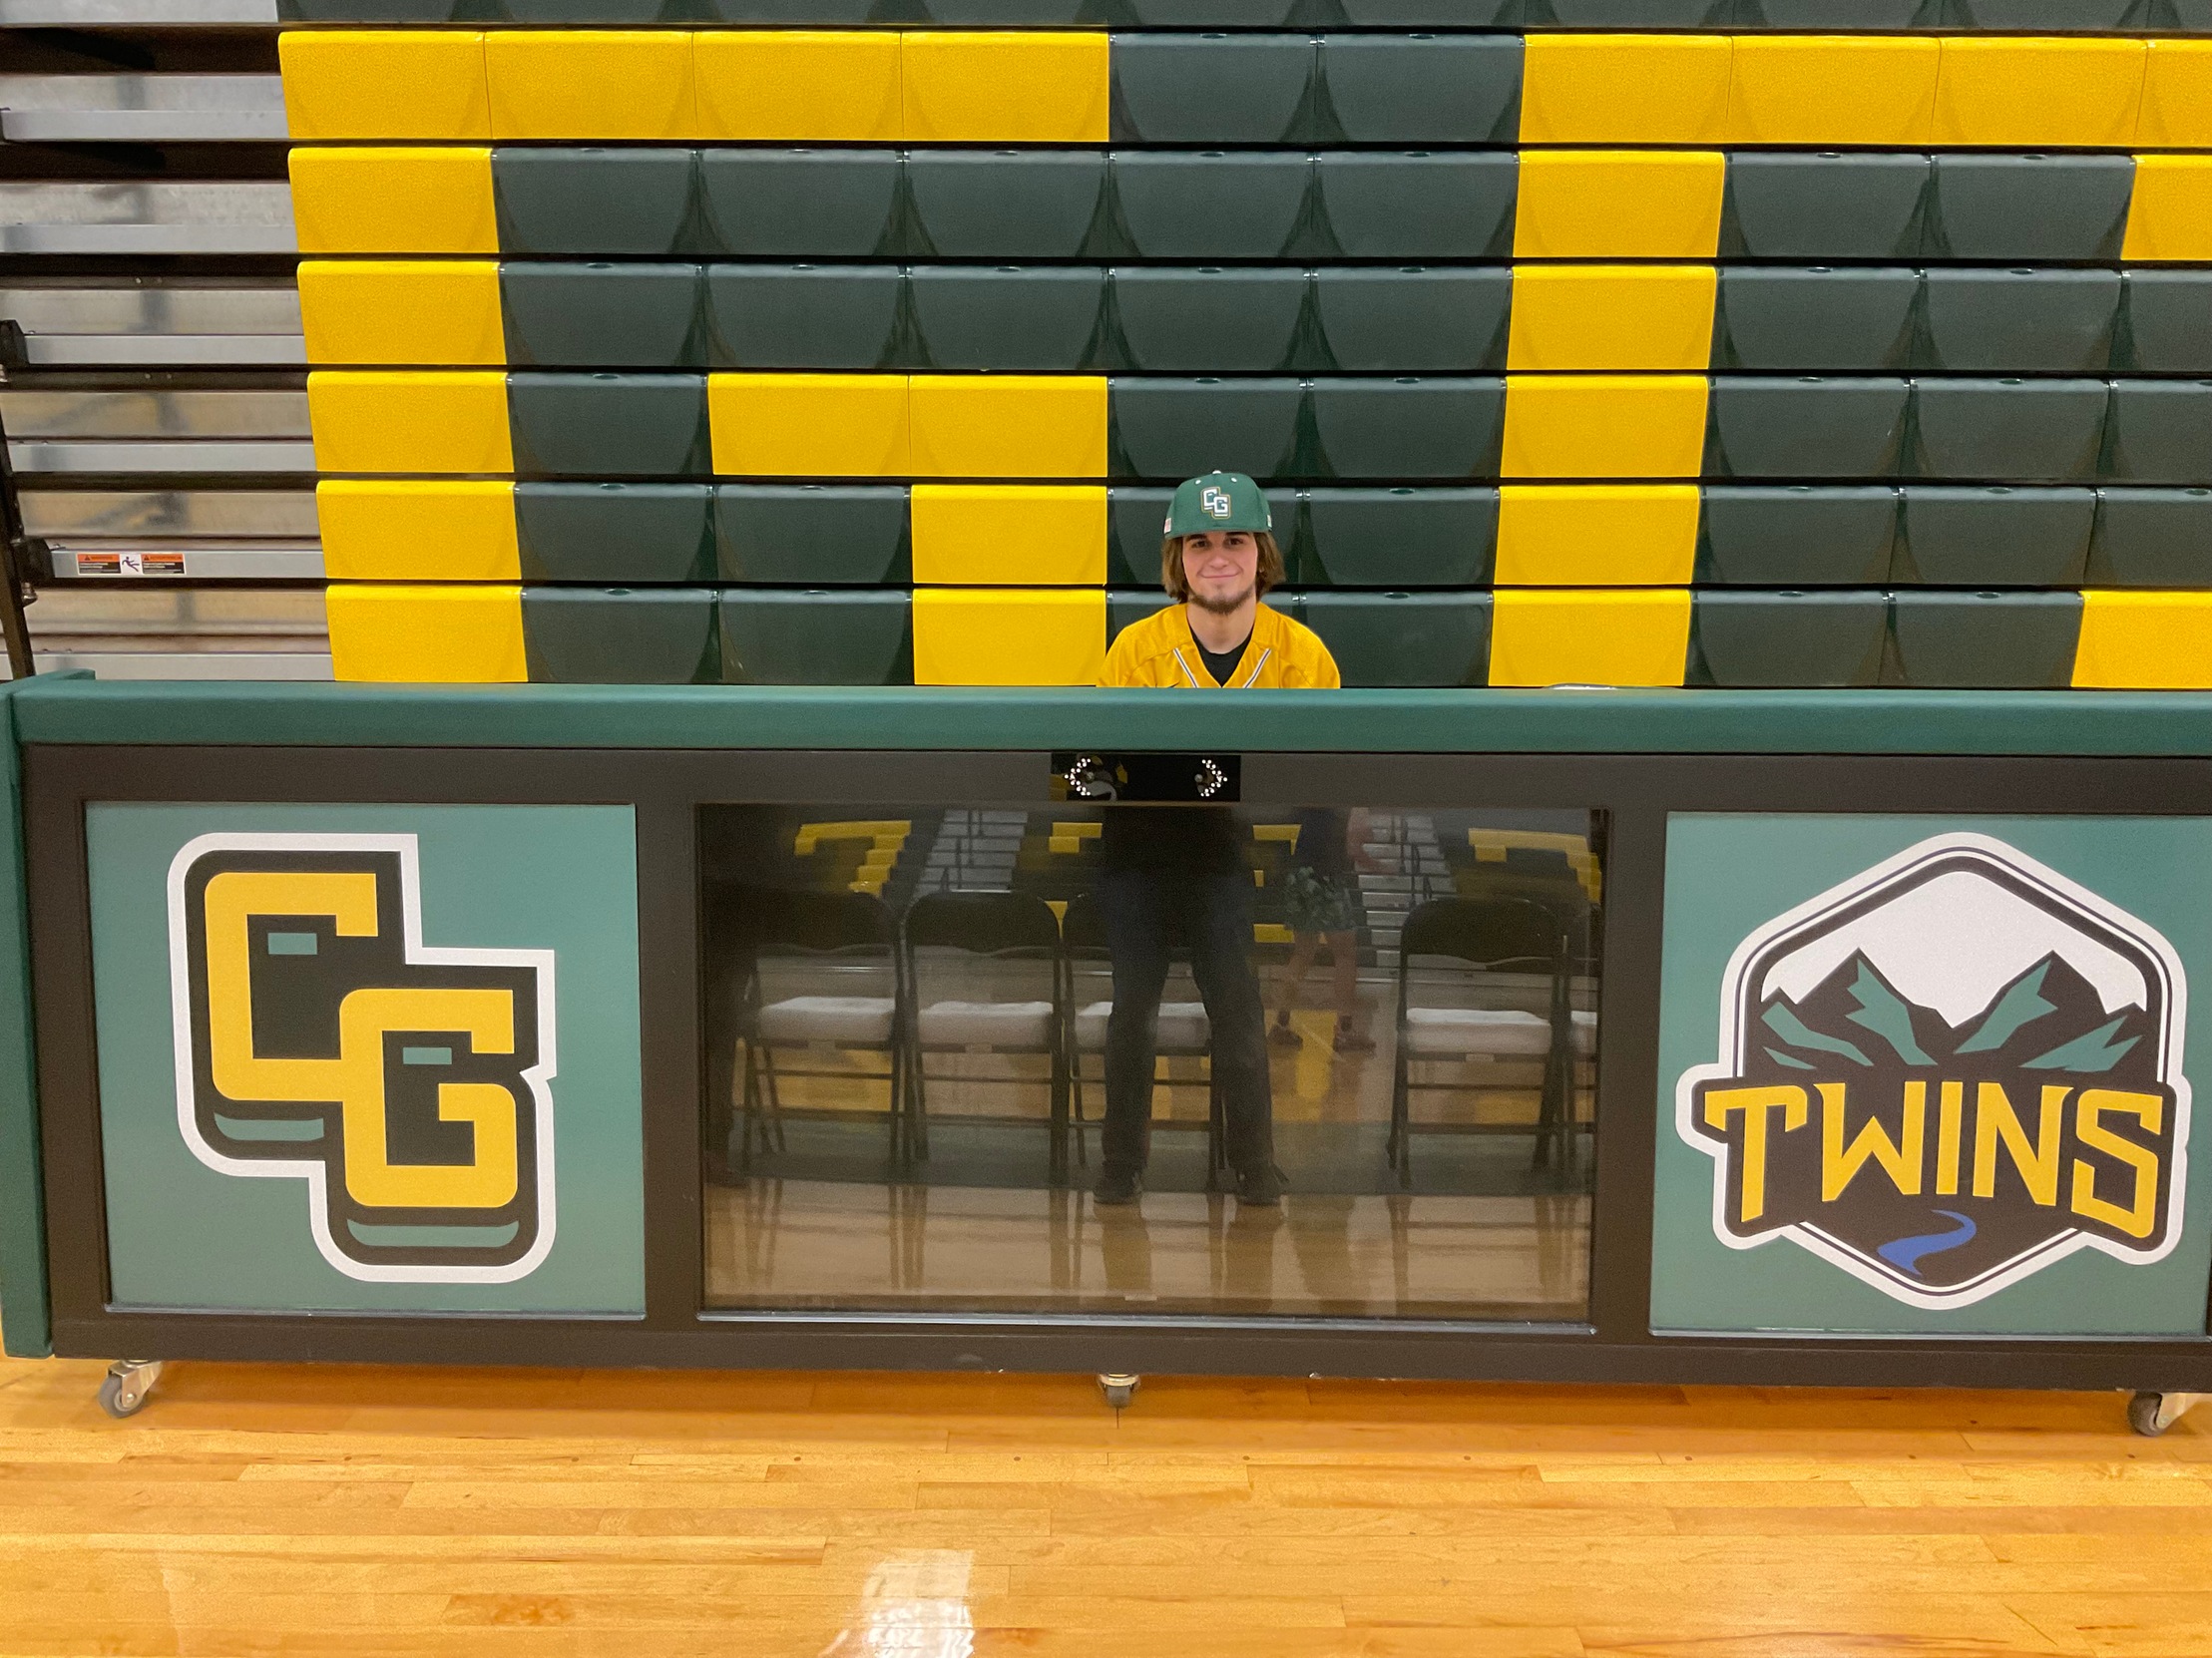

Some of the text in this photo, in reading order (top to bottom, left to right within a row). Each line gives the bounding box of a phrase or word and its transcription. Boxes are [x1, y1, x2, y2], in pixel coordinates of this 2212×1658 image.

[1202, 488, 1229, 516] CG
[203, 870, 520, 1211] CG
[1704, 1079, 2163, 1240] TWINS
